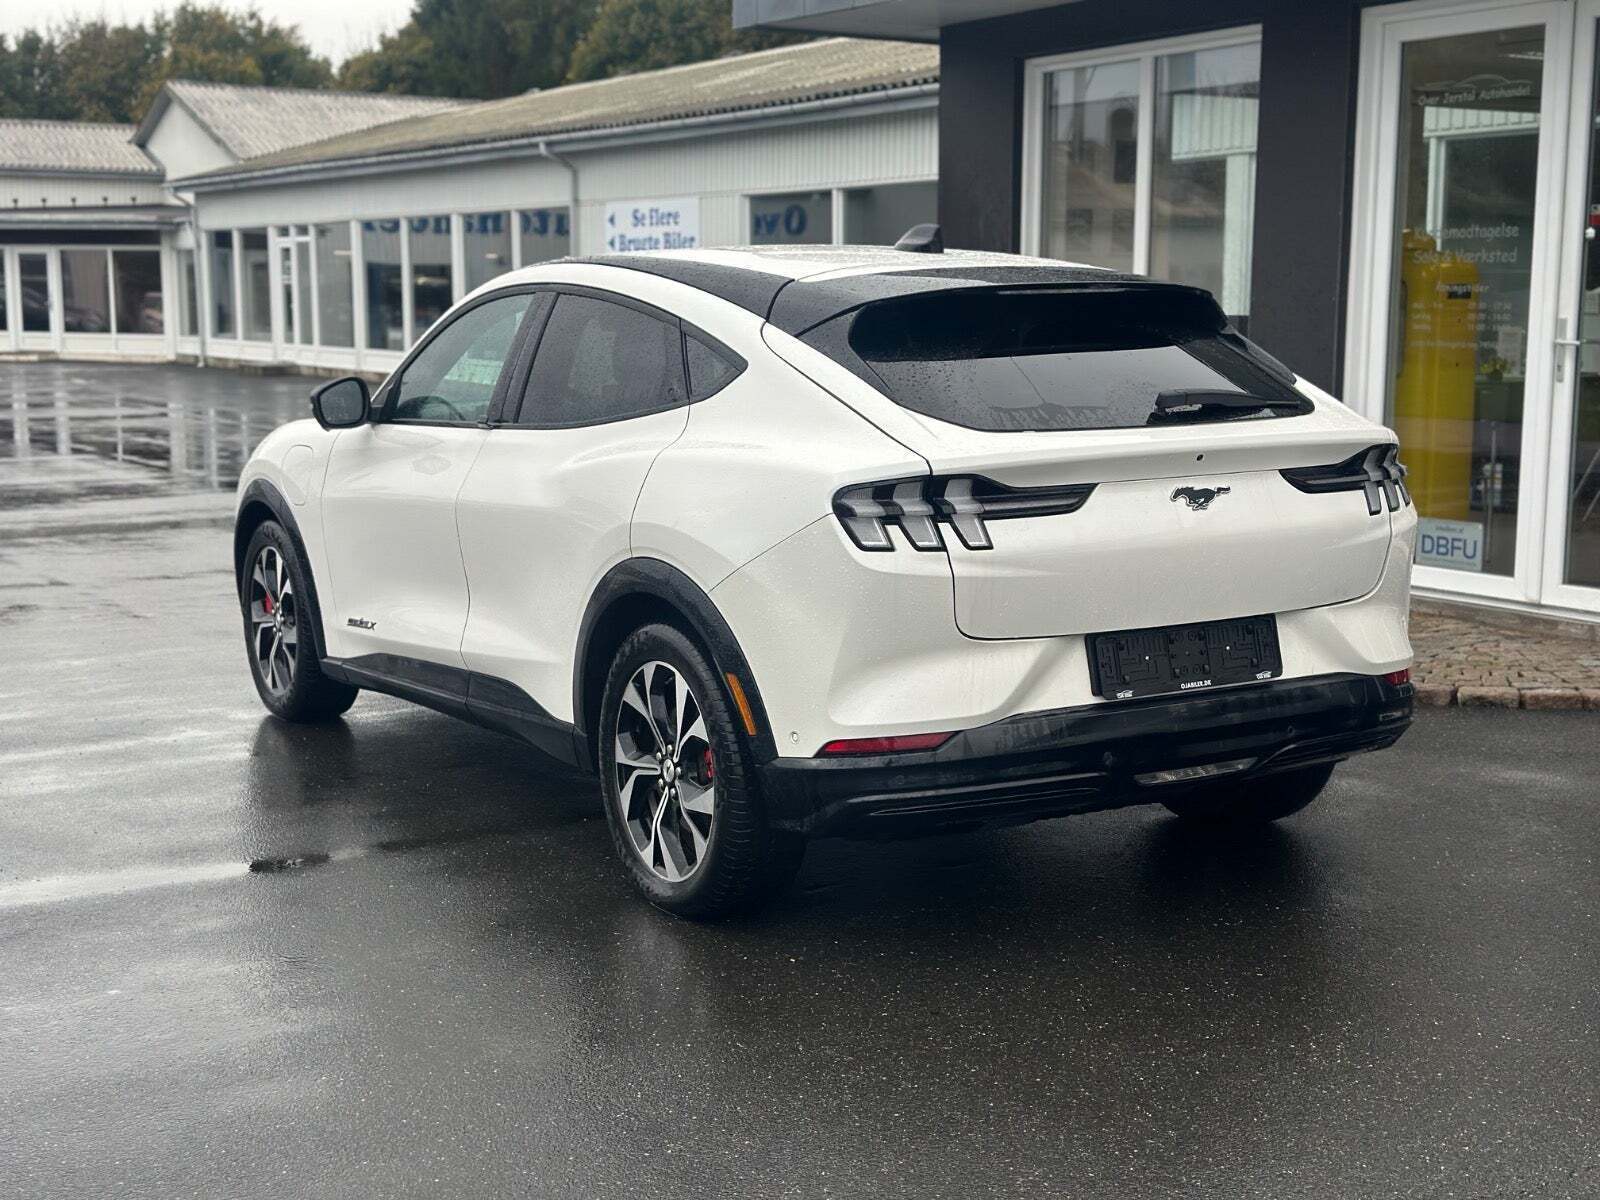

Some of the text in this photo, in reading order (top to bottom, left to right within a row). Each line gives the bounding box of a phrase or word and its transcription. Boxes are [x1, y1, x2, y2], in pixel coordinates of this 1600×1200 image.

[632, 206, 680, 227] Se flere
[663, 231, 696, 250] Biler
[1421, 534, 1477, 559] DBFU
